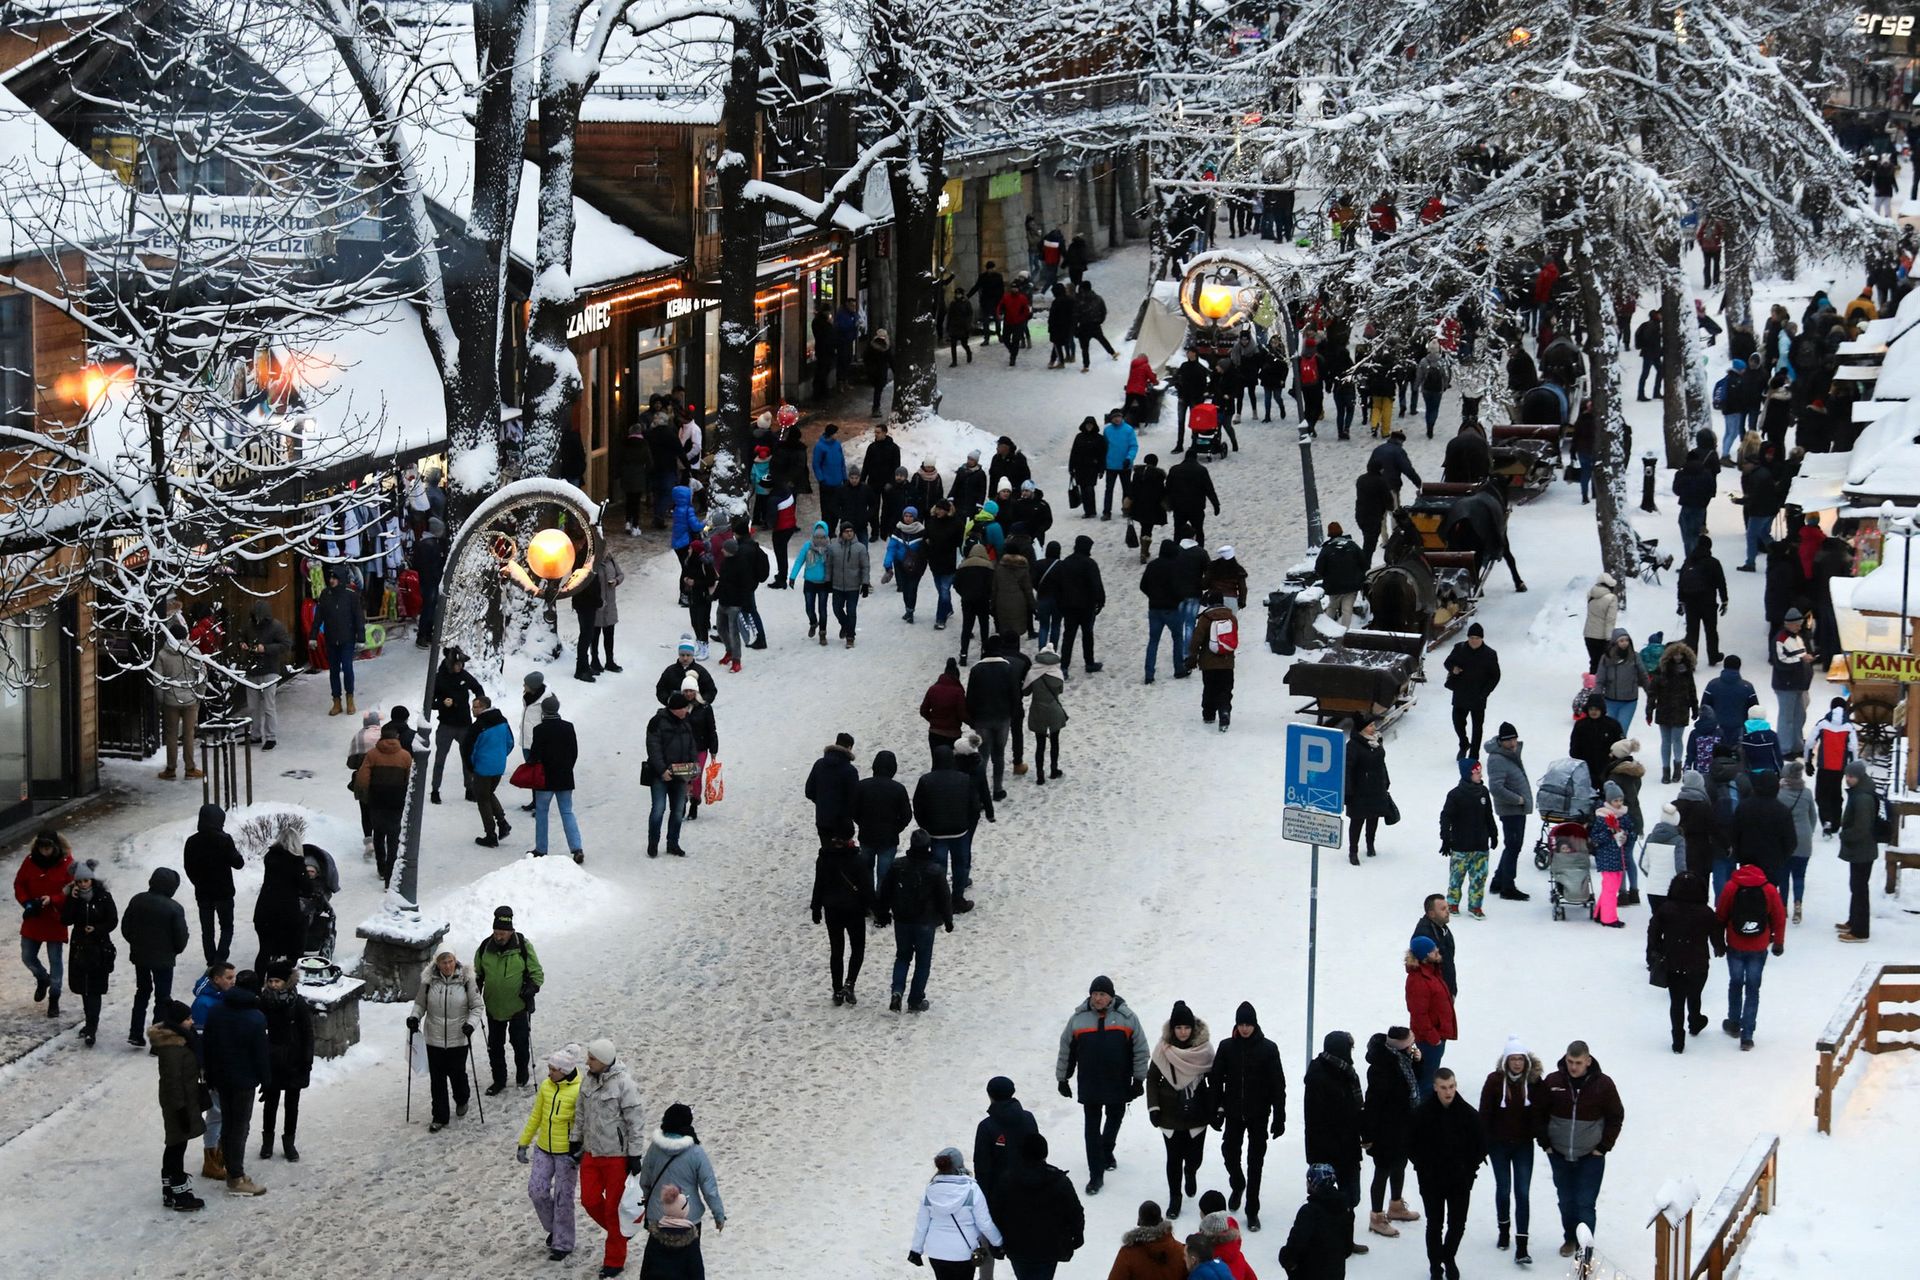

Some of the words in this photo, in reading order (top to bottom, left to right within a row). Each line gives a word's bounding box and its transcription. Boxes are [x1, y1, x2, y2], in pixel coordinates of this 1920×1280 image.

[566, 300, 611, 340] ZANIEC
[666, 297, 692, 320] KEBAB
[1299, 734, 1331, 784] P
[1287, 786, 1296, 801] 8
